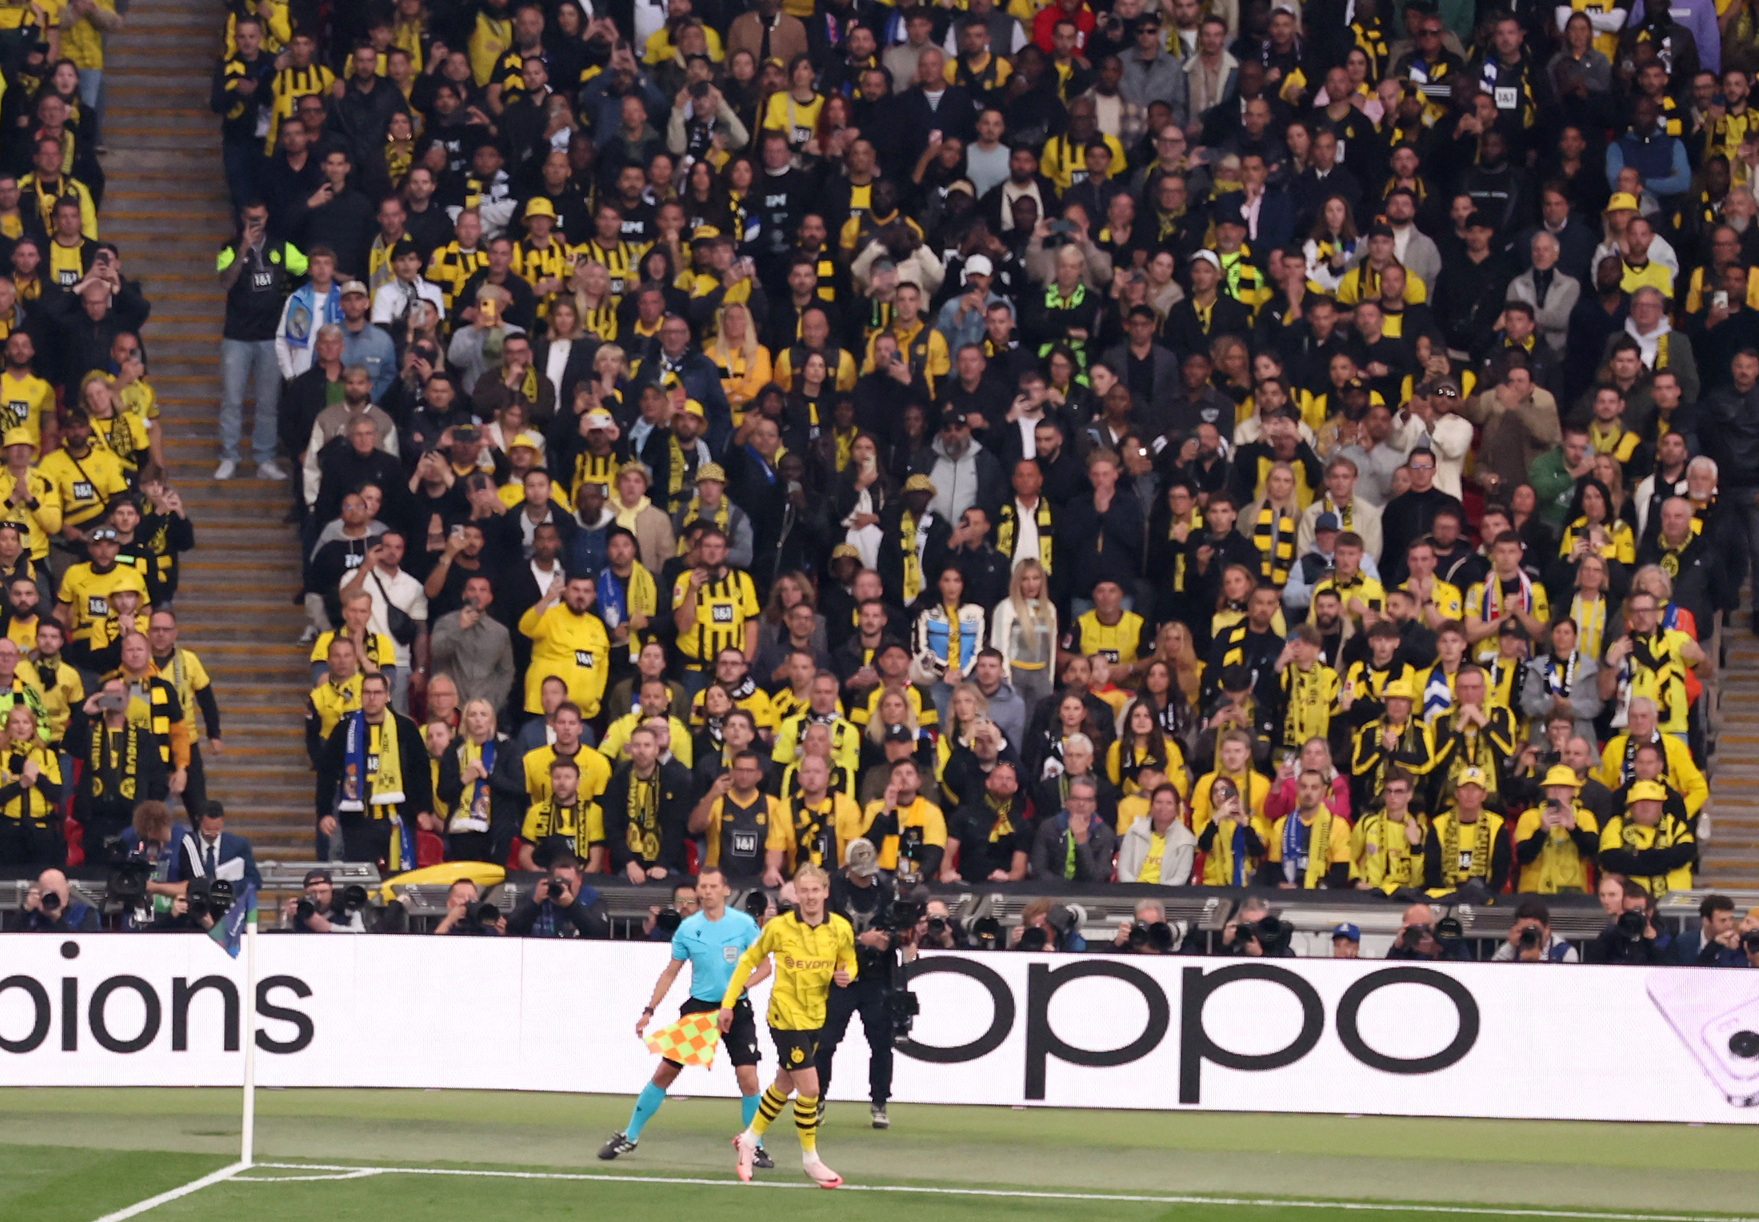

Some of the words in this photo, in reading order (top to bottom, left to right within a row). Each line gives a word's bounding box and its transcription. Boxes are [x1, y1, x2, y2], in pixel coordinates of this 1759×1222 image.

[713, 605, 731, 620] 1&1
[576, 652, 594, 667] 1&1
[734, 834, 756, 854] 1&1
[892, 956, 1480, 1104] oppo
